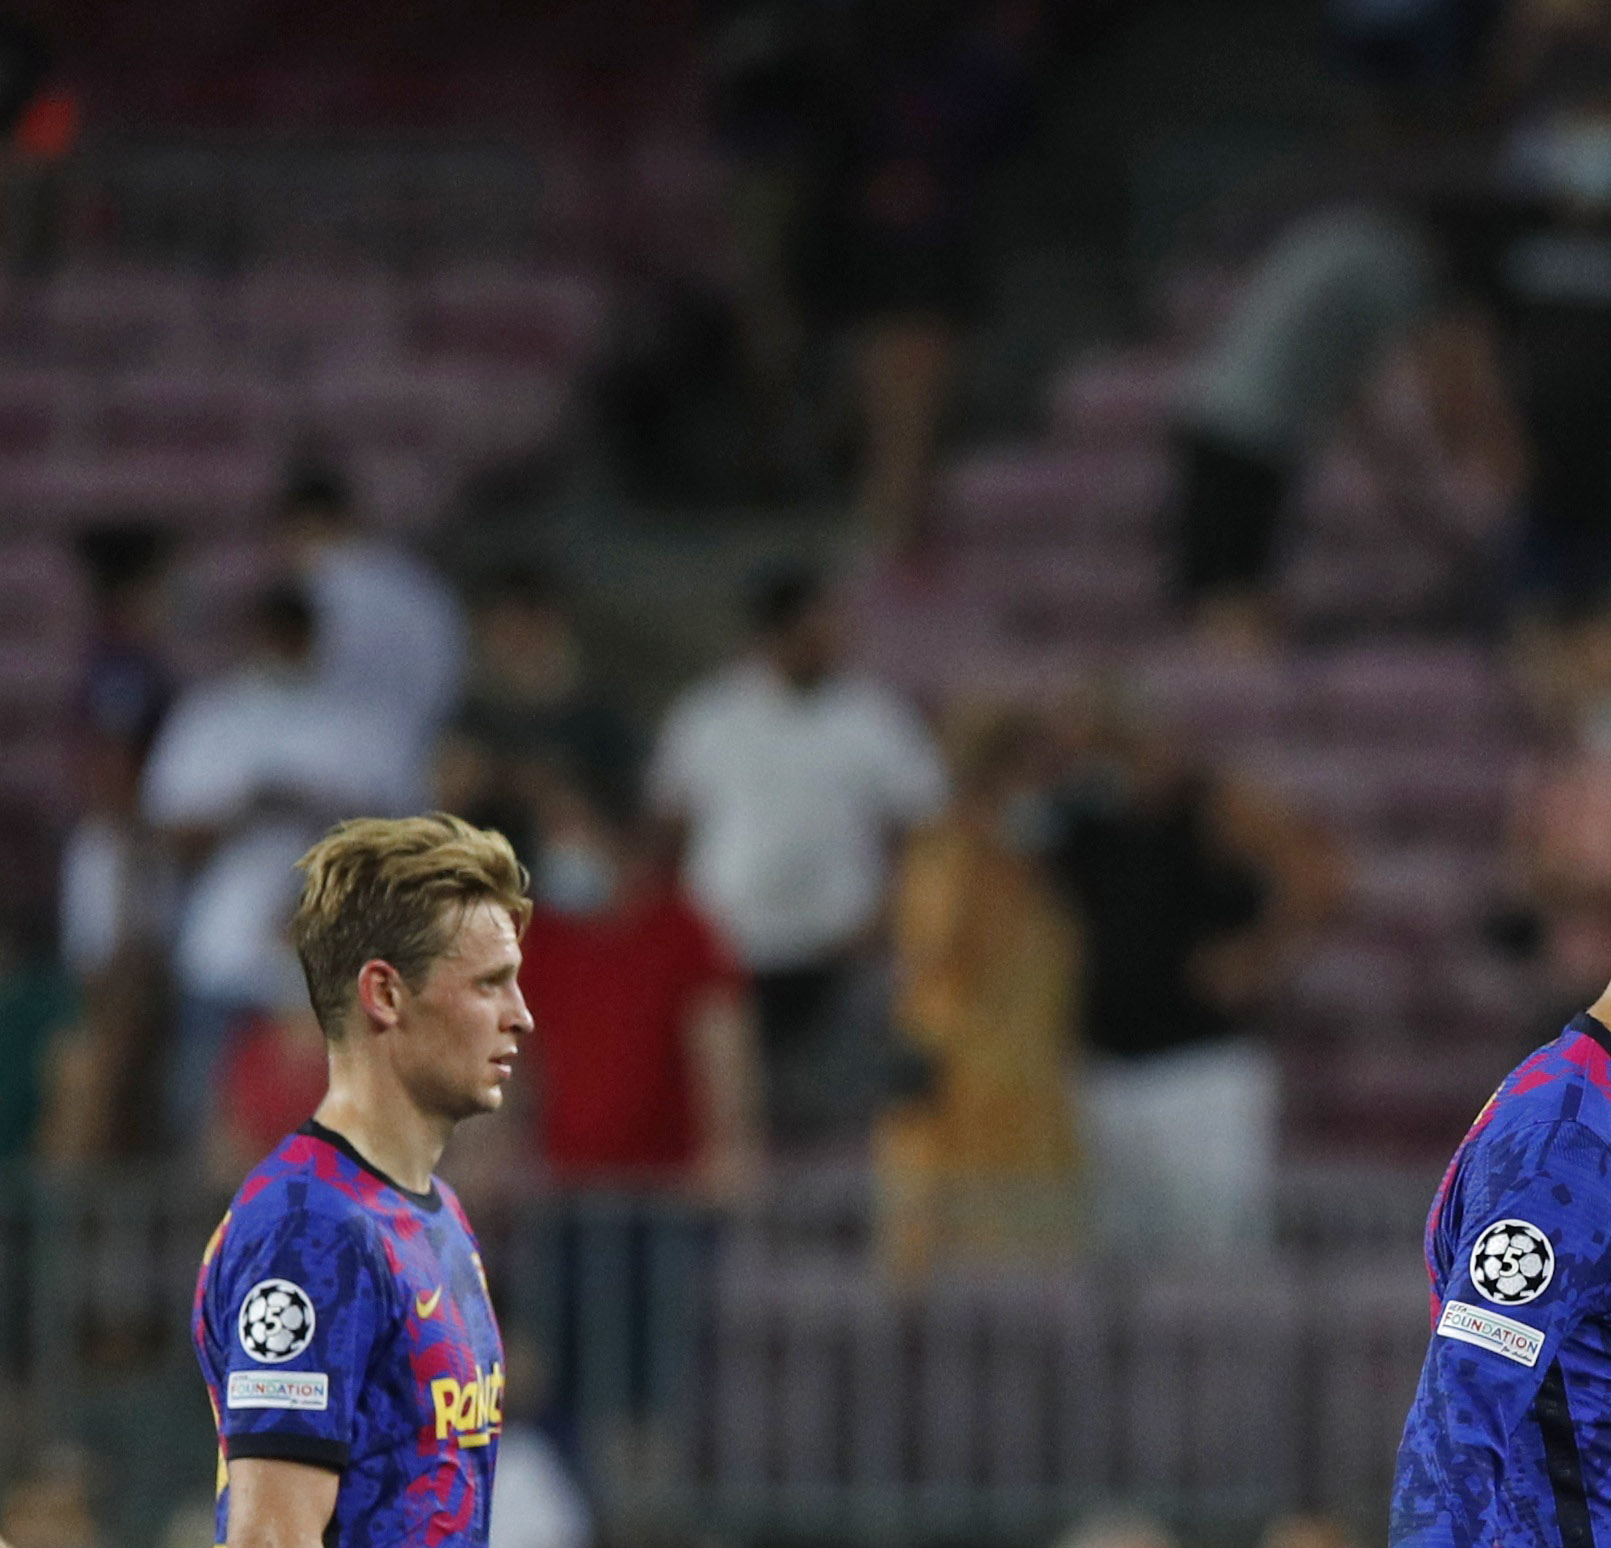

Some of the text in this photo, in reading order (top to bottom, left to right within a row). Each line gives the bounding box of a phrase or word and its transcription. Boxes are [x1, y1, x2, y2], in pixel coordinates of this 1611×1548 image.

[1500, 1246, 1523, 1277] 5
[265, 1306, 283, 1336] 5
[1444, 1312, 1539, 1354] FOUNDATION
